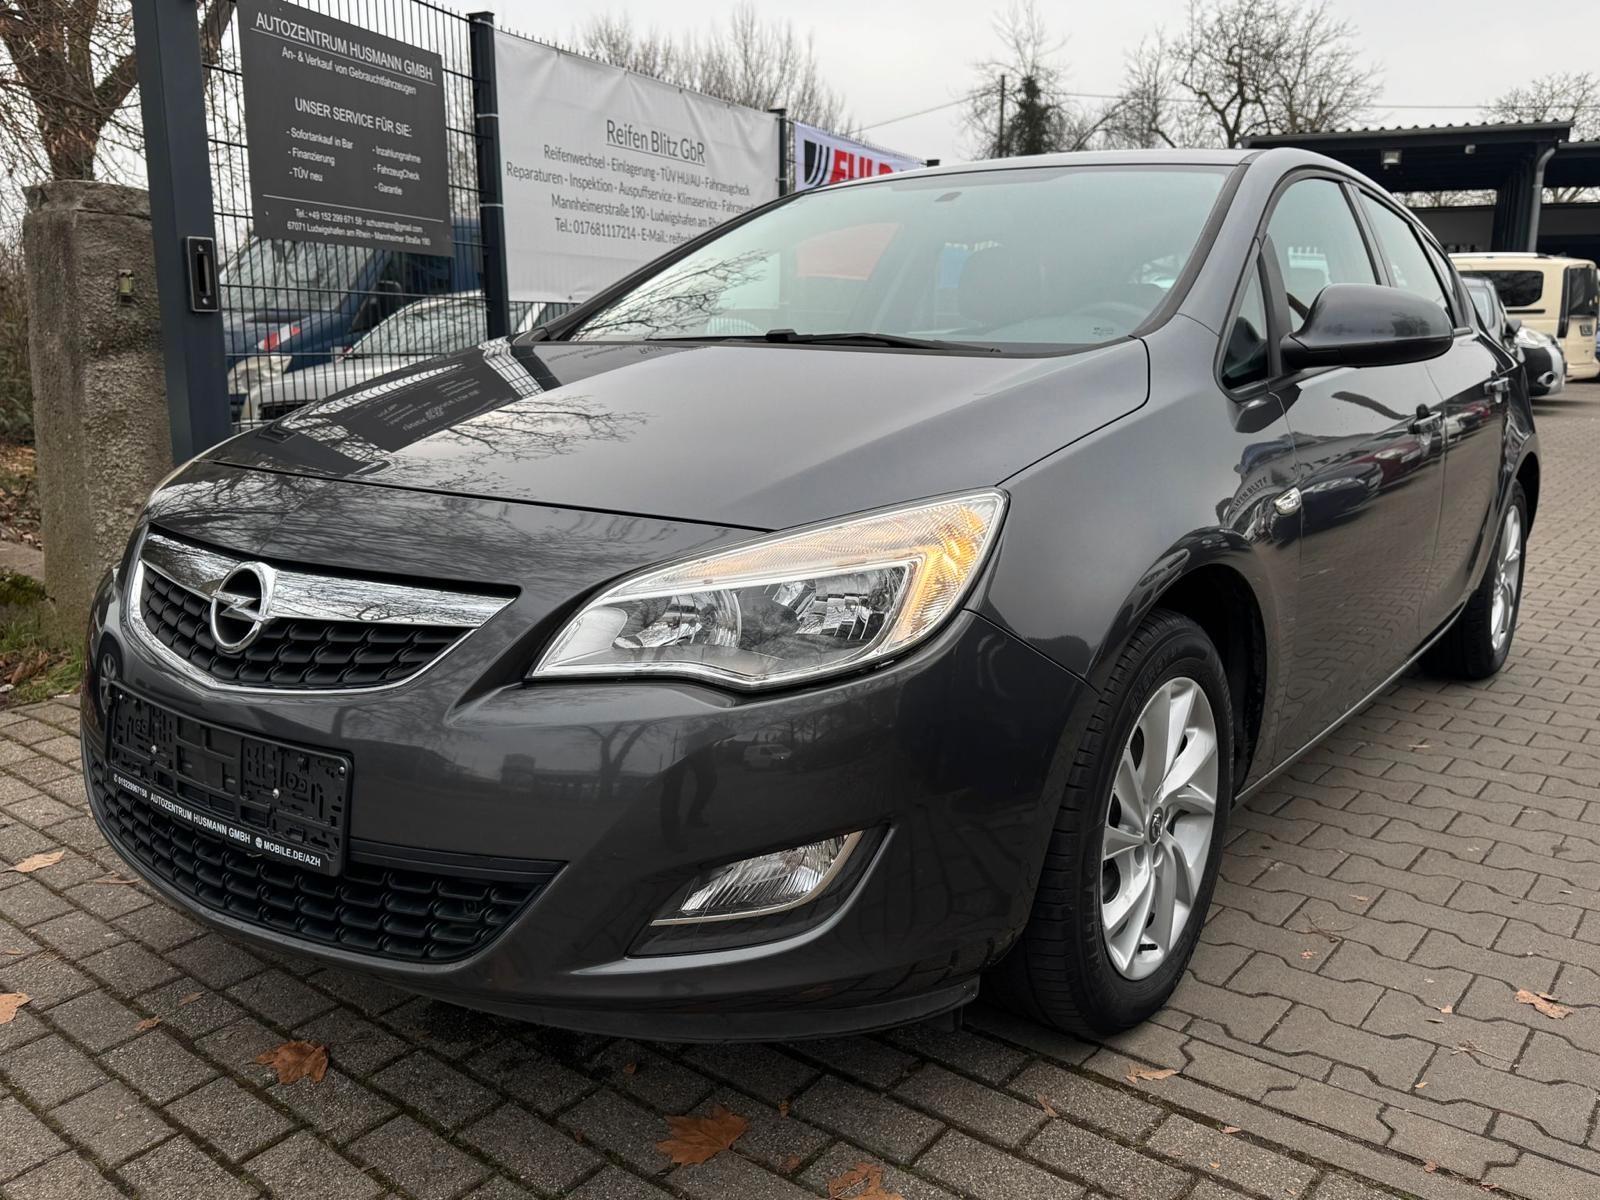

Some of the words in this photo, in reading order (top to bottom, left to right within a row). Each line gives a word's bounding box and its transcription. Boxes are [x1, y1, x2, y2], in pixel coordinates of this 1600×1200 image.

[255, 12, 347, 54] AUTOZENTRUM
[349, 42, 402, 71] HUSMANN
[403, 59, 433, 81] GMBH
[304, 52, 333, 71] Verkauf
[335, 64, 348, 75] von
[348, 66, 417, 95] Gebrauchtfahrzeugen
[294, 97, 331, 119] UNSER
[333, 108, 374, 129] SERVICE
[376, 116, 394, 133] FÜR
[606, 119, 648, 151] Reifen
[651, 130, 679, 157] Blitz
[680, 138, 705, 163] GbR
[506, 161, 563, 185] Reparaturen
[569, 173, 613, 192] Inspektion
[618, 182, 673, 202] Auspuffservice
[543, 144, 606, 169] Reifenwechsel
[611, 157, 656, 181] Einlagerung
[551, 193, 630, 218] Mannheimerstraße
[631, 205, 646, 219] 190
[650, 208, 697, 227] Ludwigshafen
[150, 792, 192, 821] AUTOZENTRUM
[193, 814, 227, 836] HUSMANN
[229, 826, 251, 844] GMBH
[263, 840, 321, 868] MOBILE.DE/AZH
